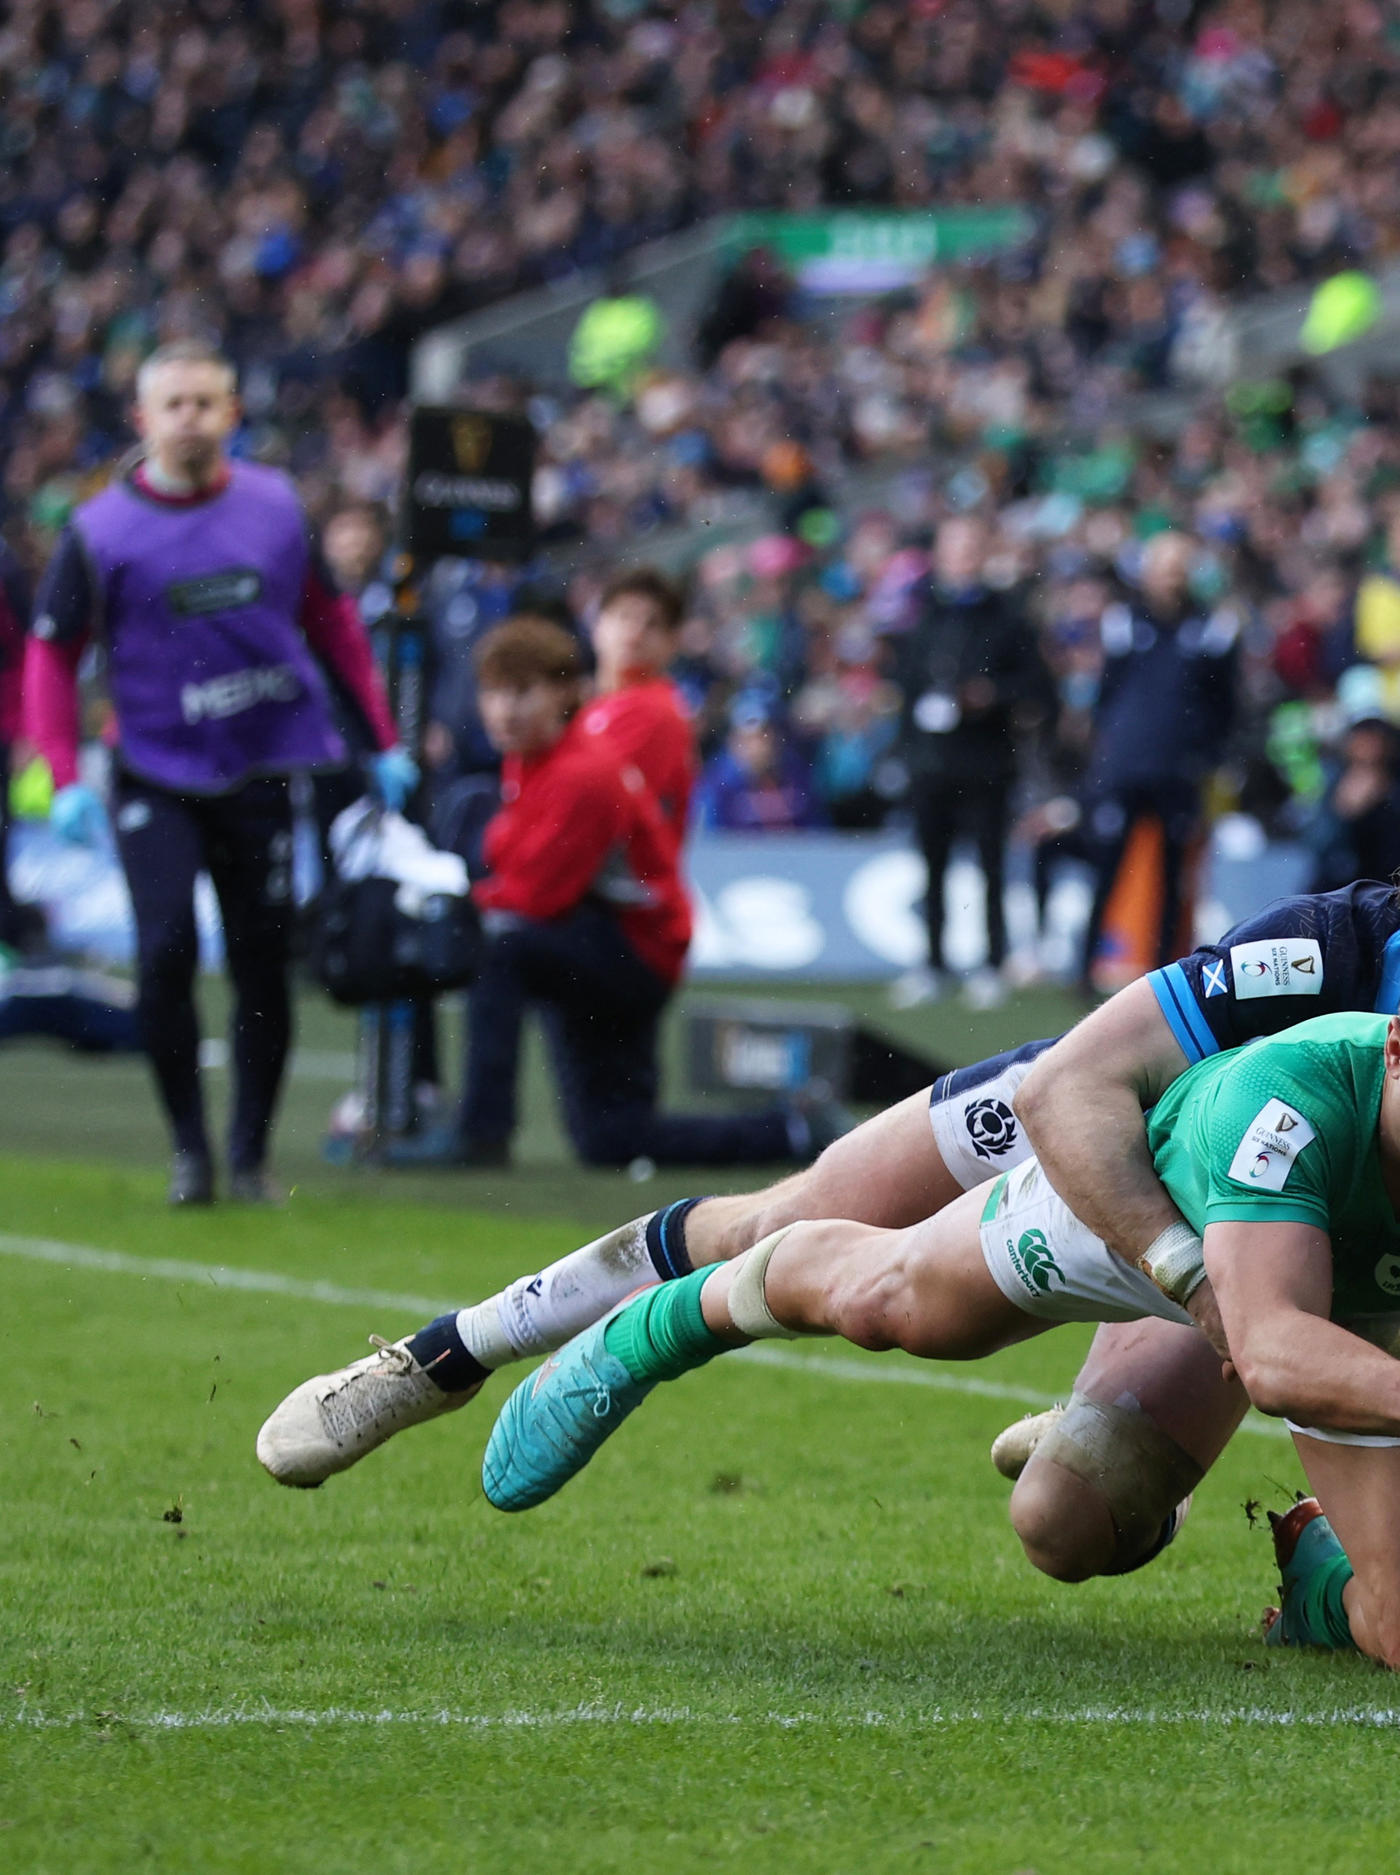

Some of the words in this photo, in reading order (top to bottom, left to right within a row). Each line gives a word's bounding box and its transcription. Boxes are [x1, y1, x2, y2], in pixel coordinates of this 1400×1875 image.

[1279, 946, 1291, 986] GUINNESS
[1256, 1127, 1291, 1151] GUINNESS
[1006, 1239, 1042, 1297] canterbury
